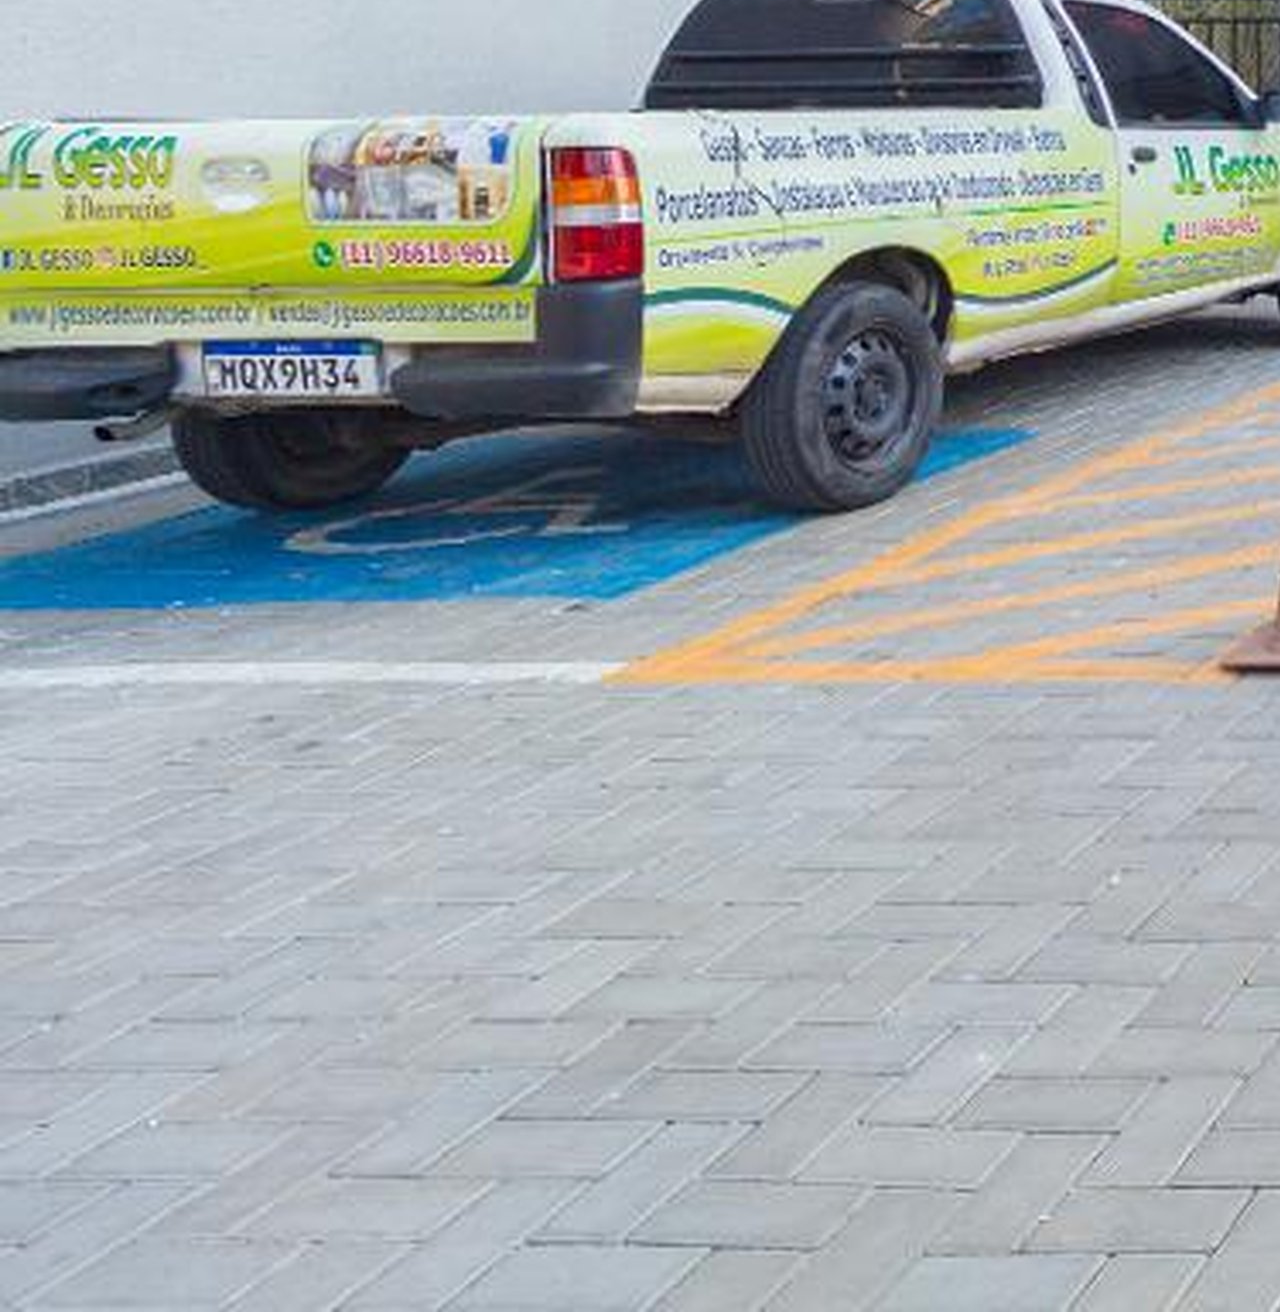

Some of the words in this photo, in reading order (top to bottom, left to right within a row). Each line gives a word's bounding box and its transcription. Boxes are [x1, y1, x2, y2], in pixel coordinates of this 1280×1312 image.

[53, 127, 178, 189] Gesso
[1174, 145, 1205, 196] JL
[1208, 144, 1280, 193] Gesso
[341, 240, 384, 271] (11)
[220, 357, 360, 390] MQX9H34
